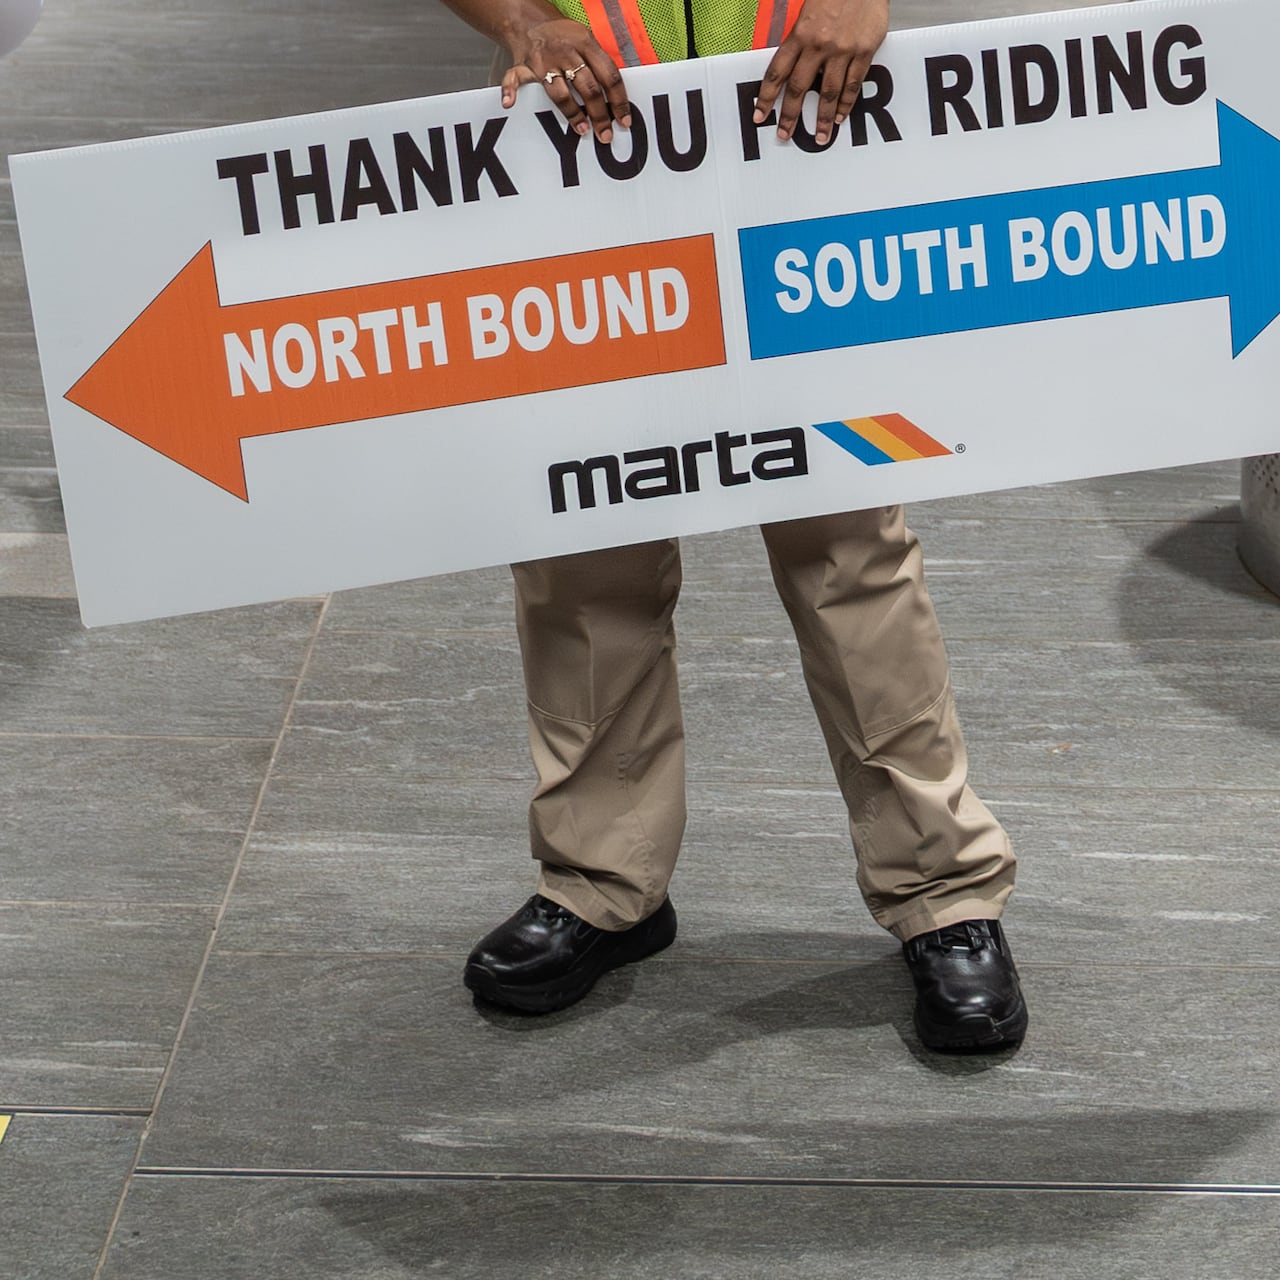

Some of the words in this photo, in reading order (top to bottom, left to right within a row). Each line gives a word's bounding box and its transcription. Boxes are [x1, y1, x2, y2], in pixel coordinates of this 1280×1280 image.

[216, 116, 519, 236] THANK
[534, 88, 708, 189] YOU
[735, 63, 903, 162] FOR
[924, 24, 1207, 137] RIDING
[774, 223, 988, 313] SOUTH
[1008, 194, 1227, 283] BOUND
[223, 301, 449, 397] NORTH
[466, 267, 690, 360] BOUND
[547, 426, 809, 514] marta
